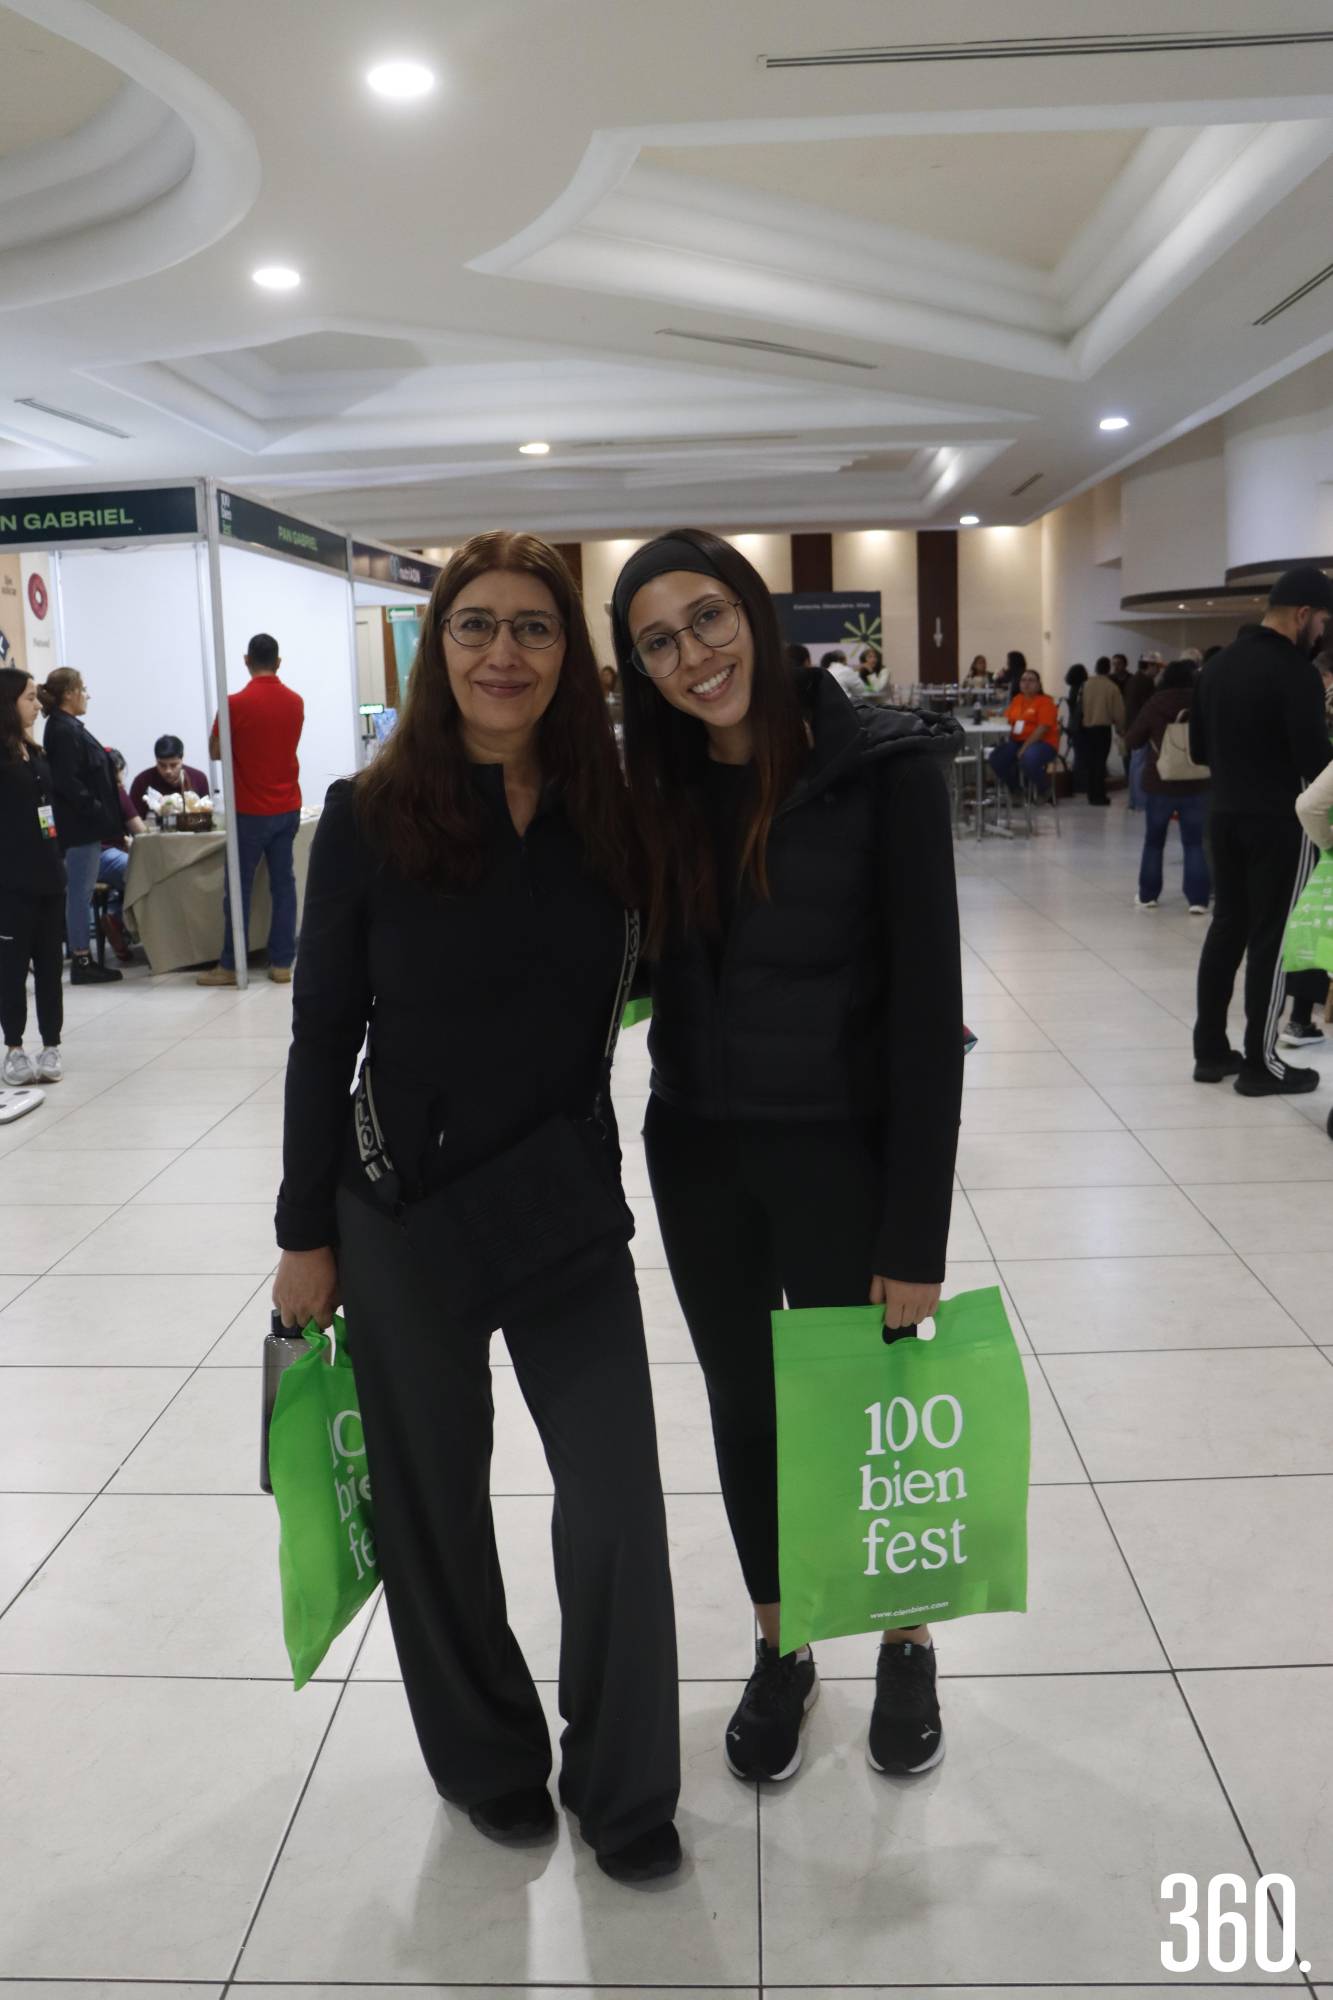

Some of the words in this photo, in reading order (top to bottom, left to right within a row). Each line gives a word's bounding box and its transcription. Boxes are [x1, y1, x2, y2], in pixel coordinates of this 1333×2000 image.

[23, 508, 134, 530] GABRIEL
[864, 1394, 963, 1456] 100
[334, 1464, 372, 1523] bie
[859, 1460, 968, 1510] bien
[348, 1521, 376, 1581] fe
[862, 1517, 968, 1576] fest
